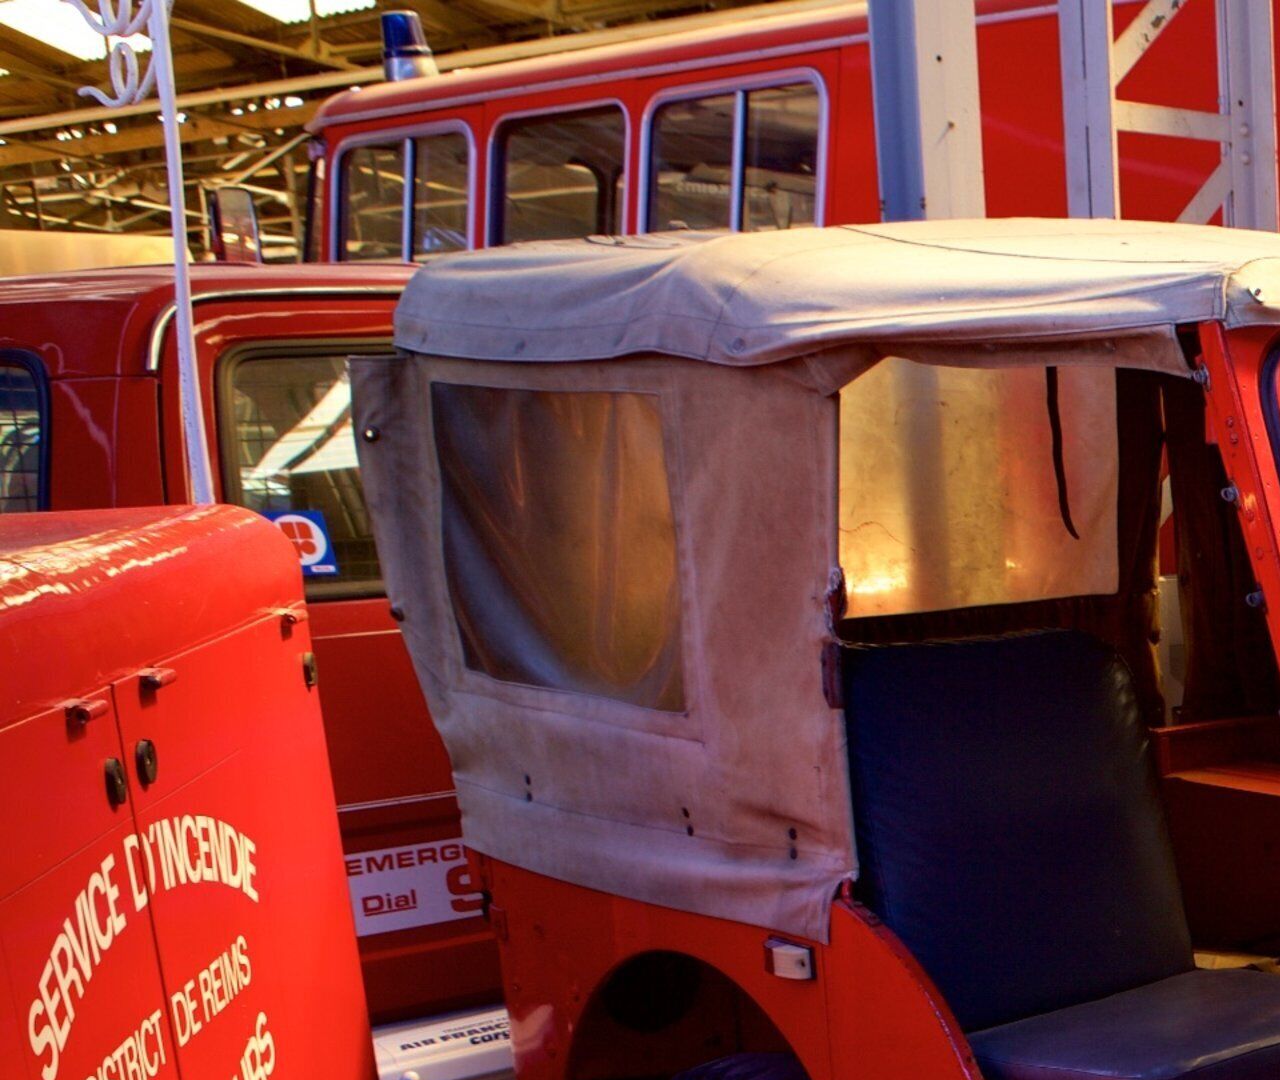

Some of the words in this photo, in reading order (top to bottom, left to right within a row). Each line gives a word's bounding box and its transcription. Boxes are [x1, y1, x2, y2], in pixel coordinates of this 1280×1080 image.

[123, 814, 259, 910] D'INCENDIE
[345, 843, 468, 877] EMERG
[362, 889, 417, 916] Dial
[171, 980, 202, 1047] DE
[201, 935, 251, 1021] REIMS
[400, 1038, 436, 1050] AIR
[440, 1021, 510, 1042] FRANC
